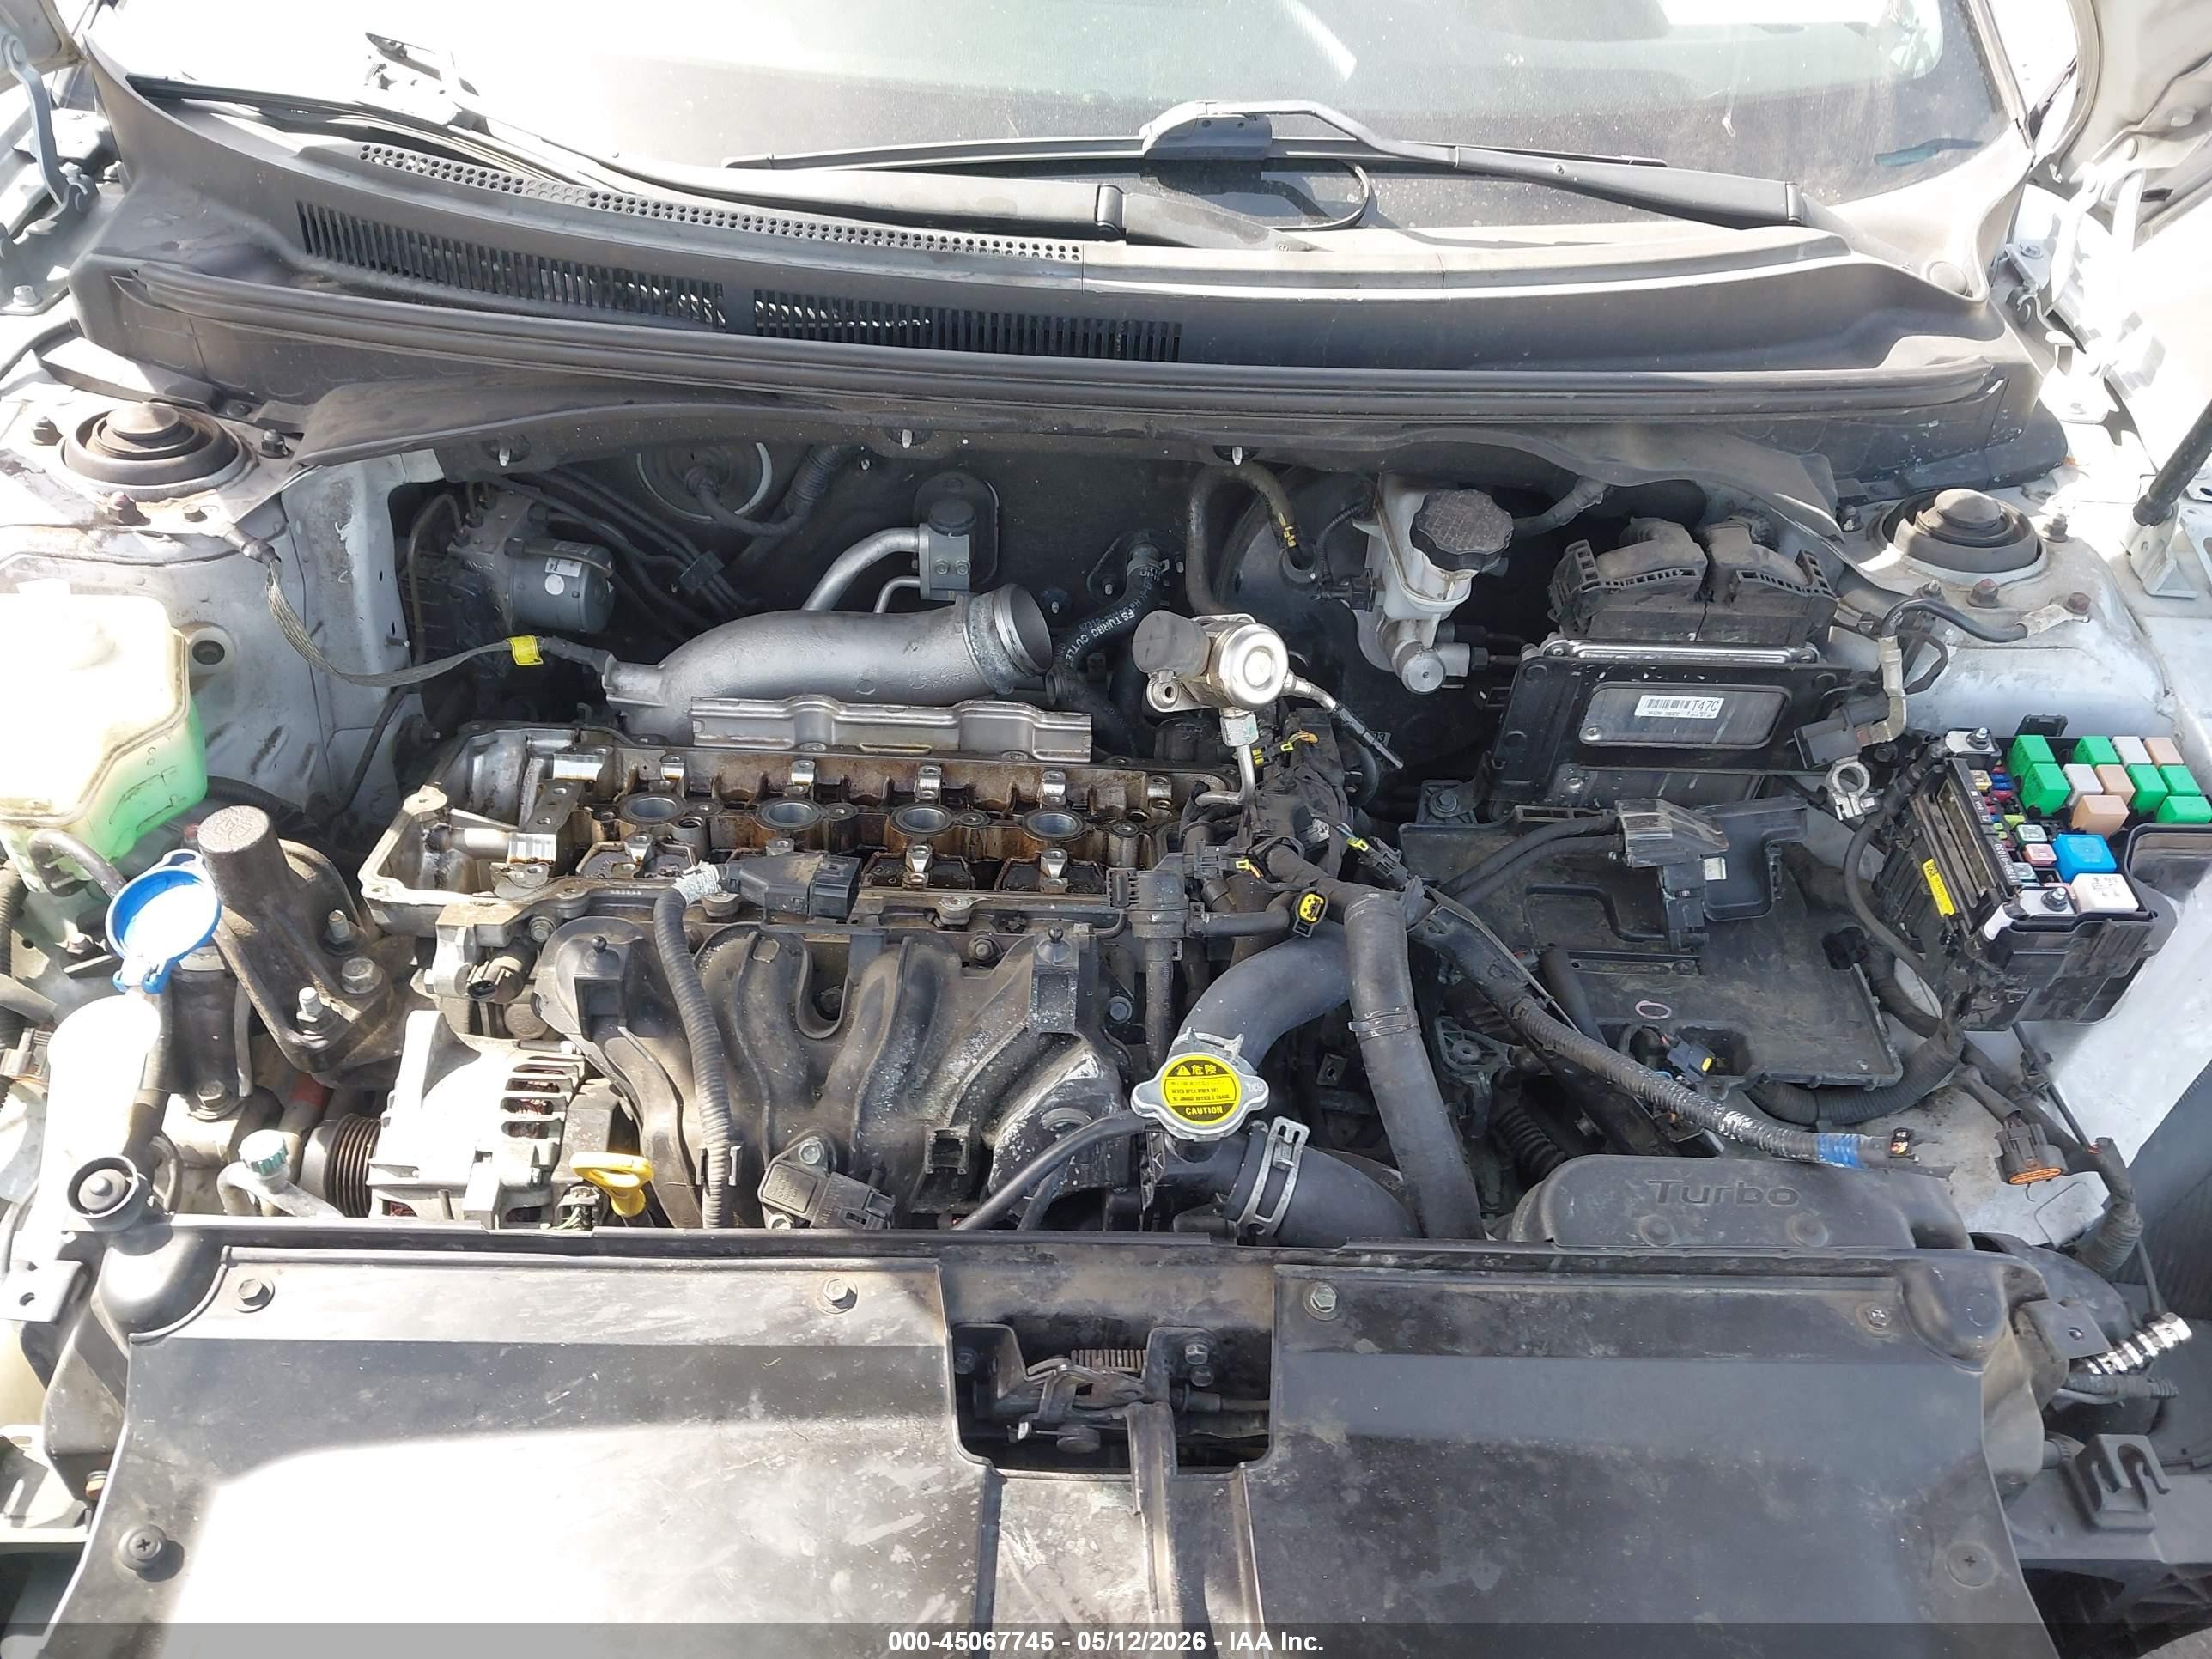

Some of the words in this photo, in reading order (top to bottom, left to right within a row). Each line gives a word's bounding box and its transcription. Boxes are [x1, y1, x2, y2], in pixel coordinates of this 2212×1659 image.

[1121, 608, 1135, 621] FS
[1091, 616, 1122, 638] TURBO
[1692, 700, 1719, 711] T47C
[1191, 1064, 1218, 1075] 危険
[1185, 1105, 1223, 1115] CAUTION
[1646, 1179, 1801, 1206] Turbo
